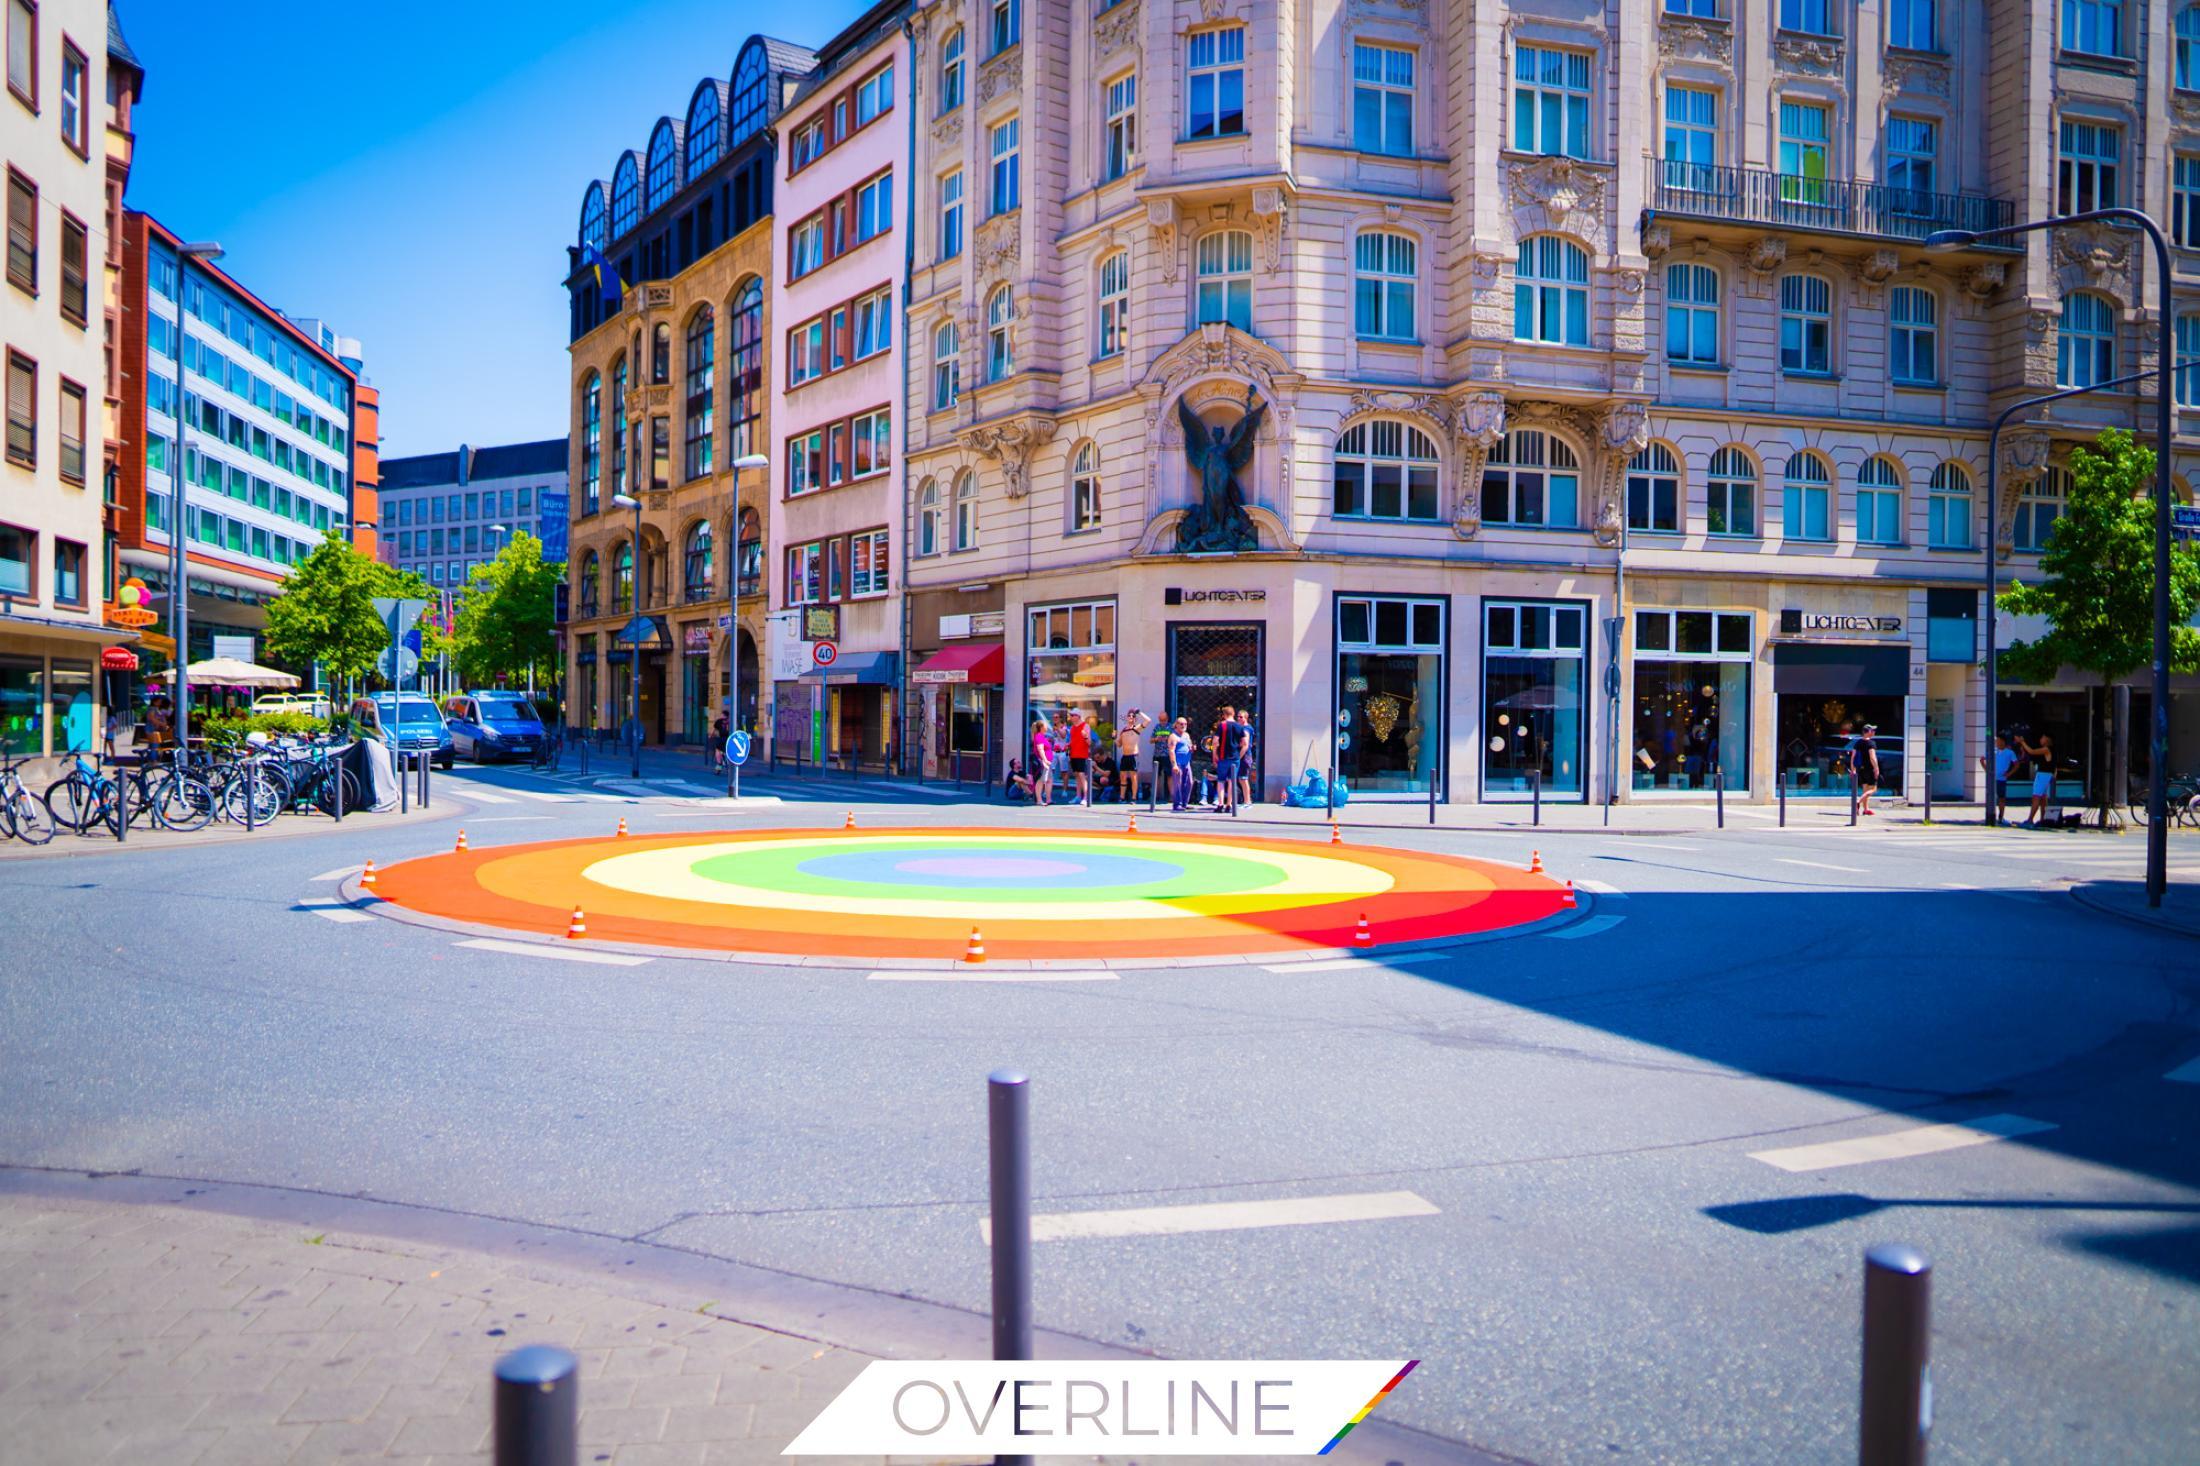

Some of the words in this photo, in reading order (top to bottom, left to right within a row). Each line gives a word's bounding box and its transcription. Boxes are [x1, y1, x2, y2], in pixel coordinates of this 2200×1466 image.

[1184, 591, 1266, 602] LICHTCENTER
[1805, 615, 1902, 631] LICHTCENTER
[818, 648, 833, 660] 40
[1912, 667, 1924, 675] 44
